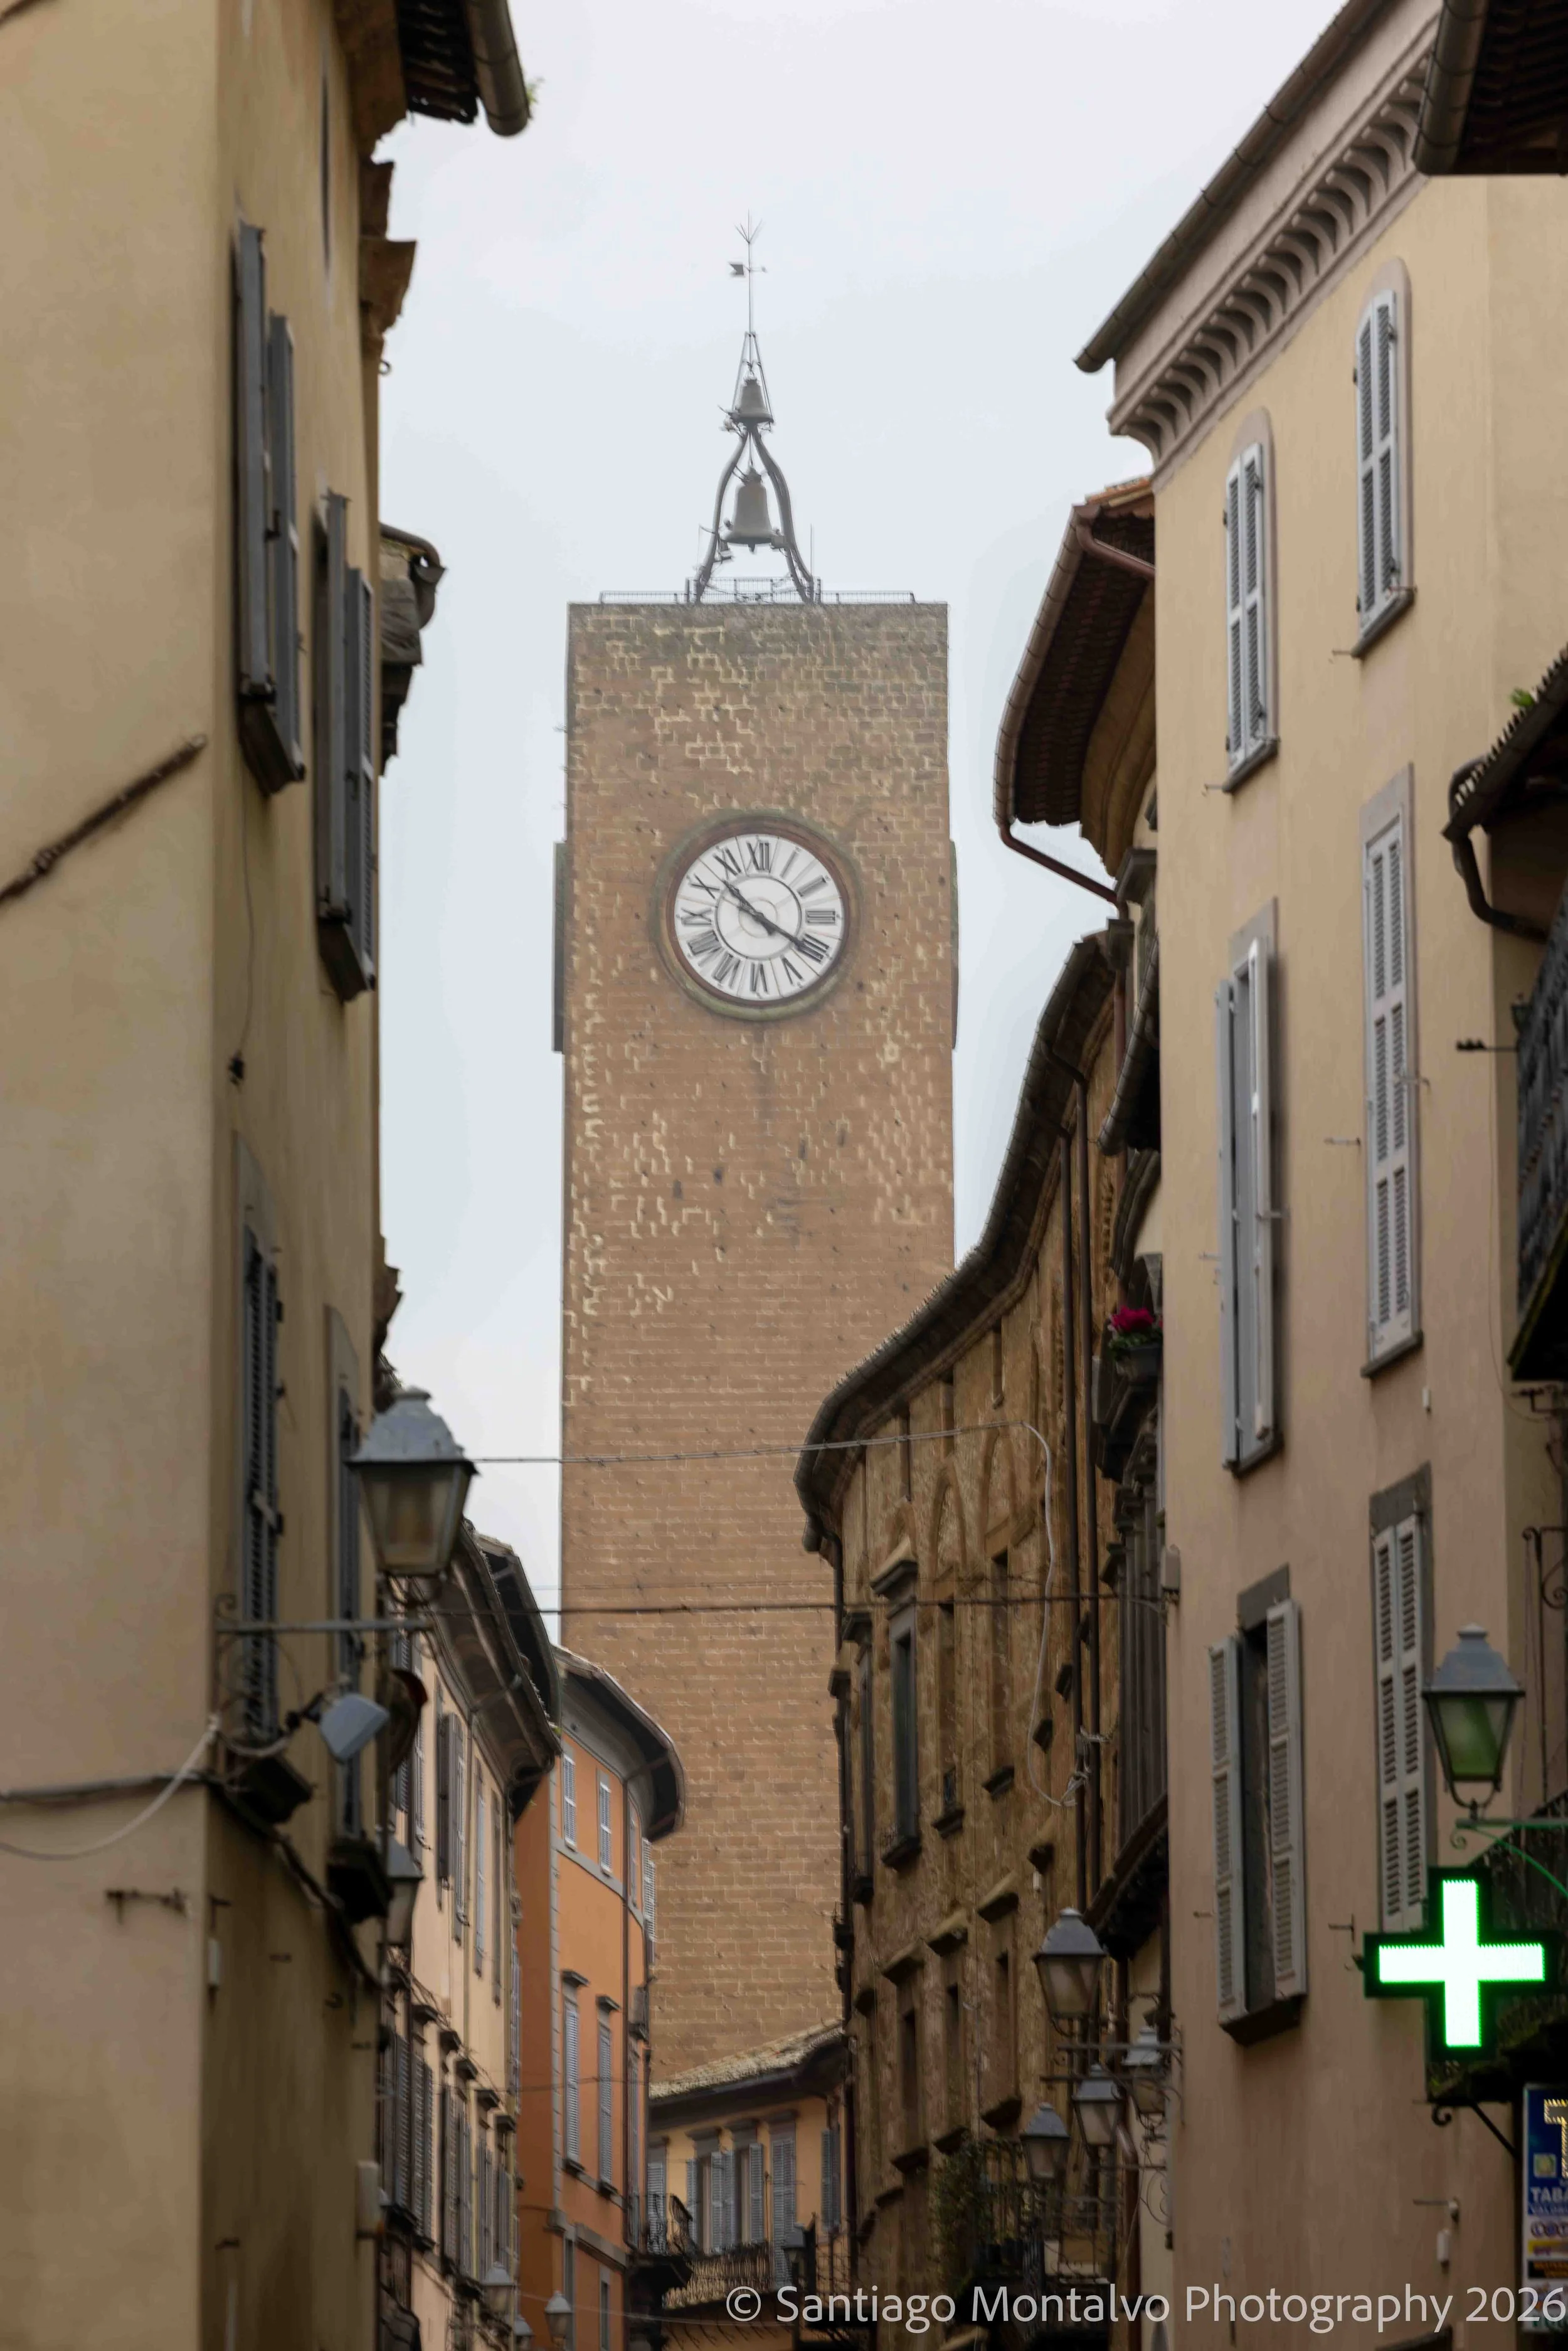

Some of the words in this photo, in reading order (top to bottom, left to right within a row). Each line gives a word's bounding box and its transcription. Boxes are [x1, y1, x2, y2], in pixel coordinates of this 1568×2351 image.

[713, 847, 742, 879] XI
[745, 841, 770, 873] XII
[780, 849, 799, 879] I
[689, 874, 720, 900] X
[797, 875, 827, 898] II
[805, 909, 836, 925] III
[750, 961, 768, 994] VI
[780, 955, 803, 985] V
